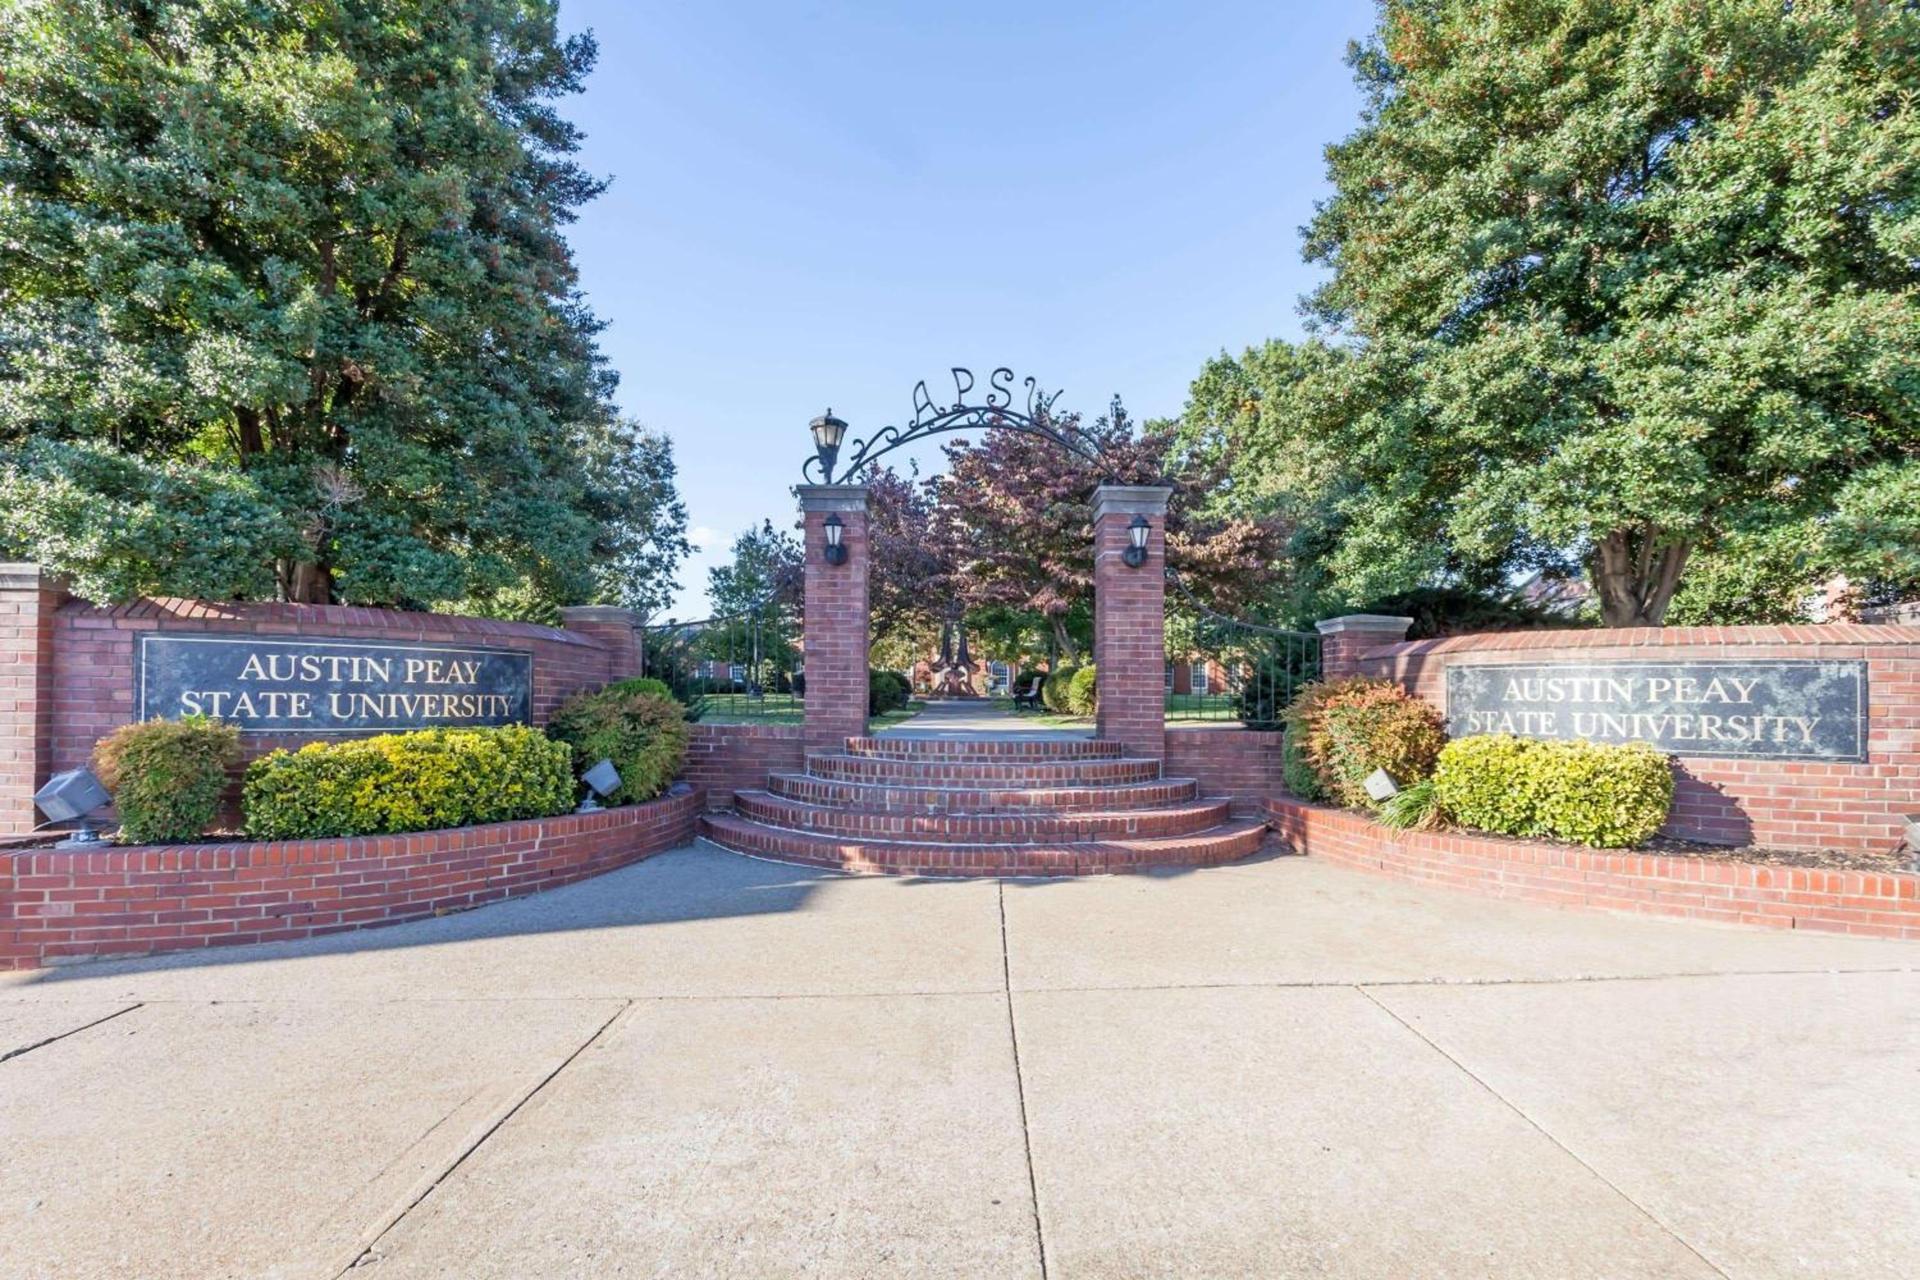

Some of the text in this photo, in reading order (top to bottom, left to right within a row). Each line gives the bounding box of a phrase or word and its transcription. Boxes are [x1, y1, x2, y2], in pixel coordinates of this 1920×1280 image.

[237, 653, 481, 685] AUSTIN PEAY
[180, 690, 514, 719] STATE UNIVERSITY
[1503, 676, 1762, 704] AUSTIN PEAY
[1467, 710, 1822, 743] STATE UNIVERSITY
